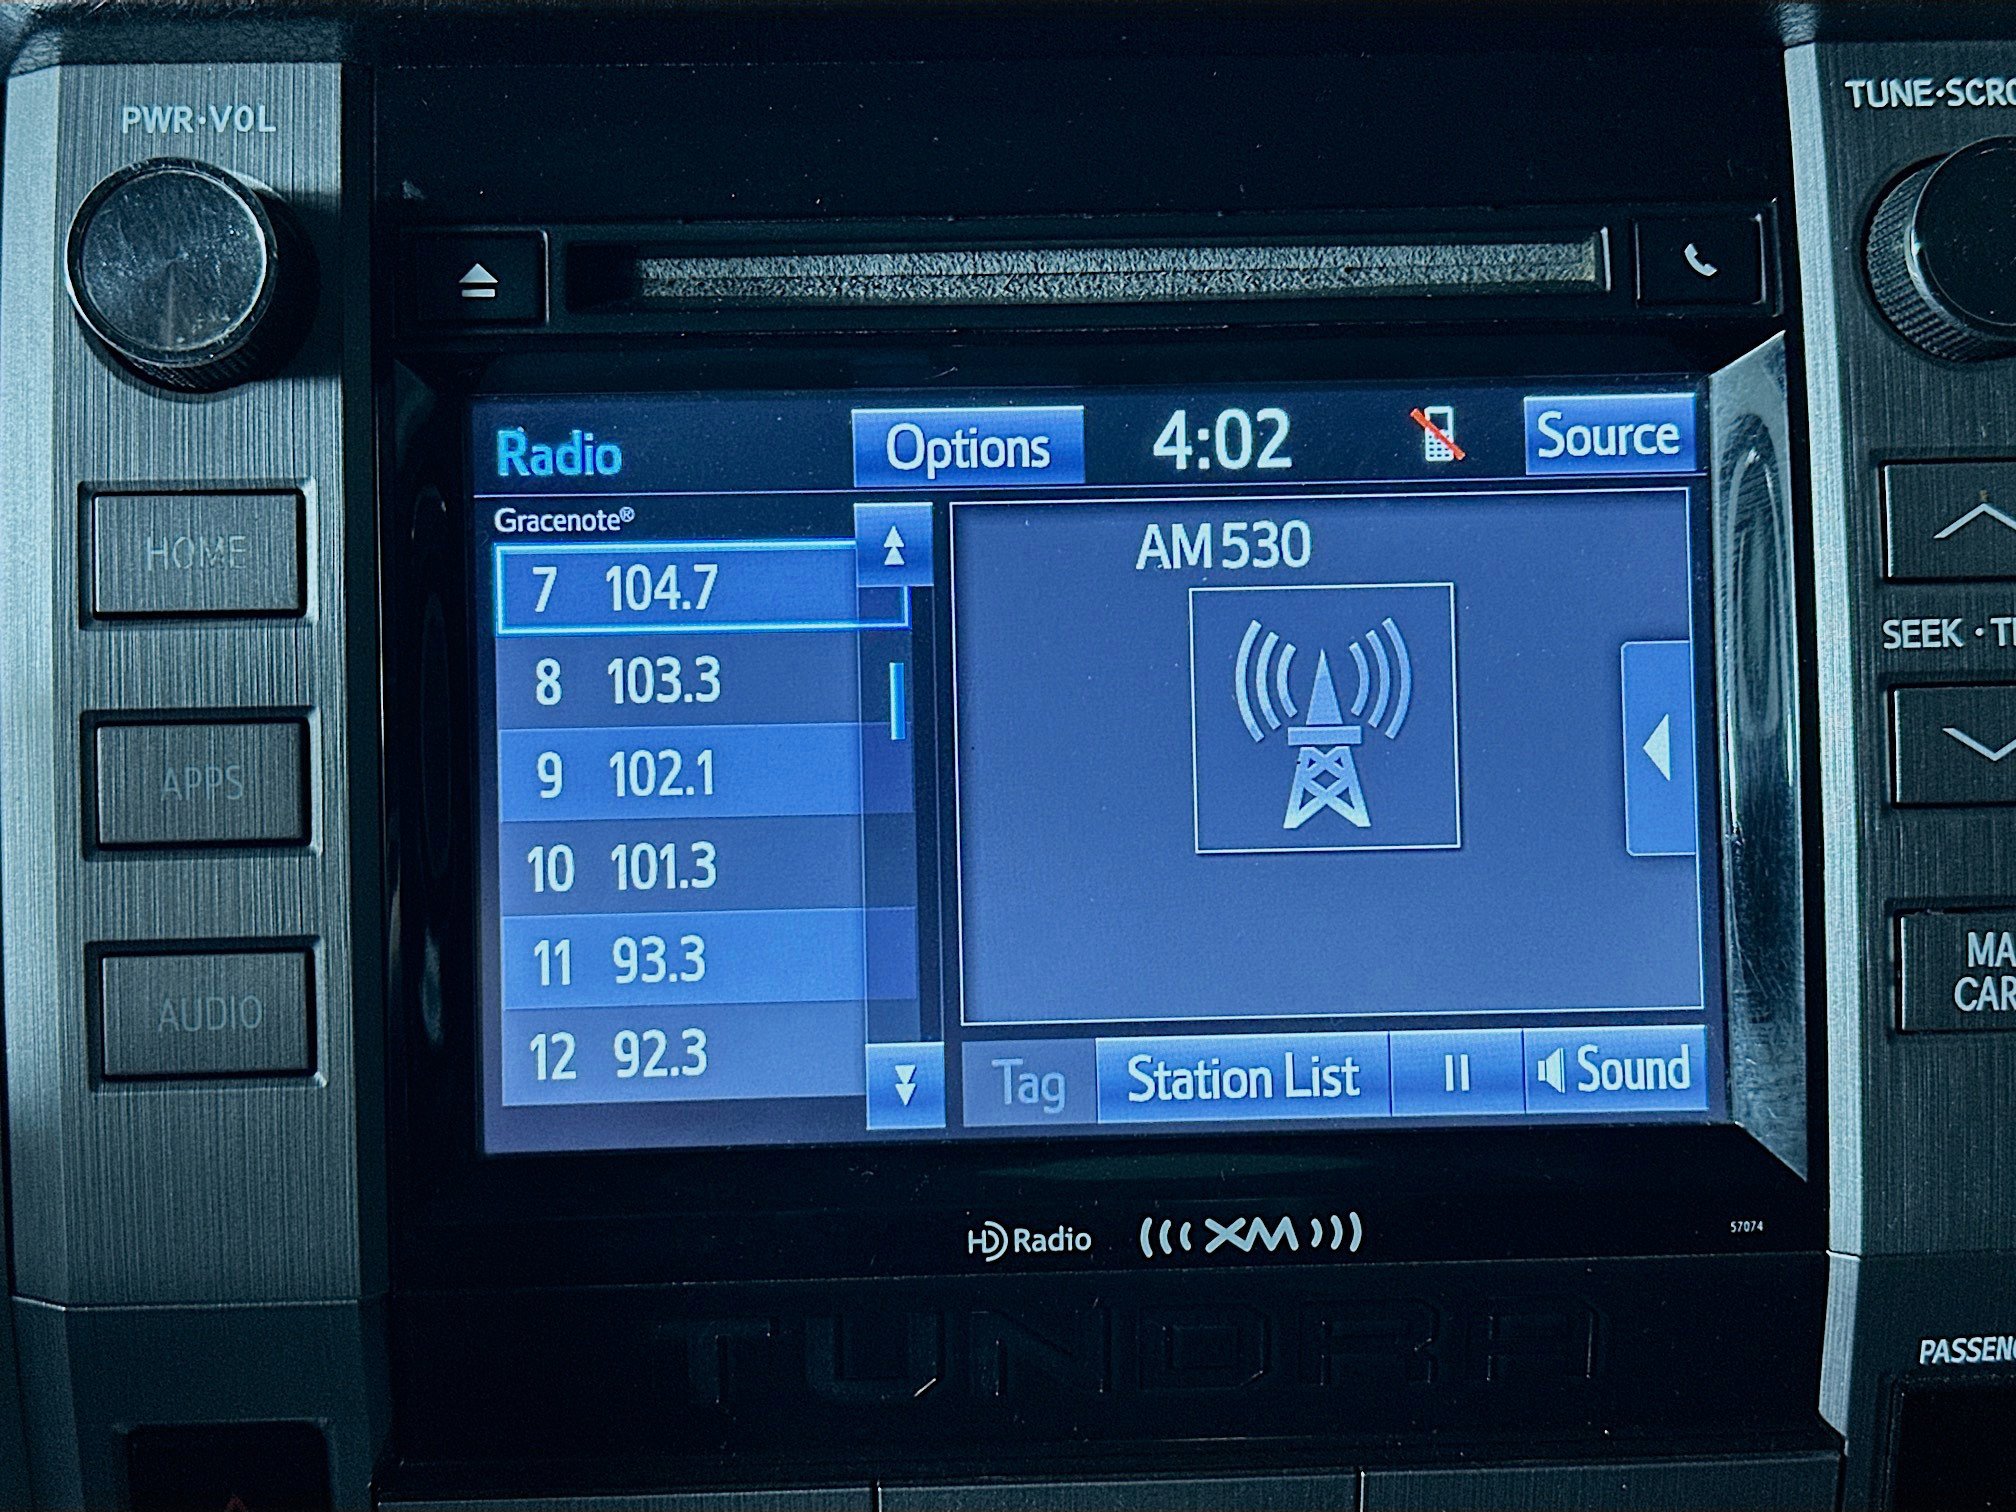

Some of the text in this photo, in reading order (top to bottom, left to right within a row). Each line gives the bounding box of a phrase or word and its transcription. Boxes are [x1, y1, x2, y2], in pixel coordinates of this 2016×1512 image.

[497, 428, 623, 477] Radio
[886, 422, 1051, 480] Options
[1152, 408, 1293, 471] 4:02
[1537, 411, 1681, 459] Source
[147, 535, 247, 573] HOME
[532, 563, 718, 613] 7 104.7
[1882, 617, 2016, 649] SEEK T
[535, 655, 721, 705] 8 103.3
[161, 766, 245, 802] APPS
[537, 749, 715, 799] 9 102.1
[527, 841, 718, 893] 10 101.3
[534, 935, 707, 986] 11 93.3
[158, 995, 265, 1033] AUDIO
[529, 1028, 709, 1081] 12 92.3
[1127, 1051, 1361, 1102] Station List
[1577, 1044, 1691, 1092] Sound
[991, 1058, 1066, 1114] Tag
[1013, 1225, 1092, 1254] Radio
[1730, 1220, 1764, 1233] 57074
[652, 1297, 1606, 1404] TUNDRA
[1920, 1336, 2016, 1364] PASSEN
